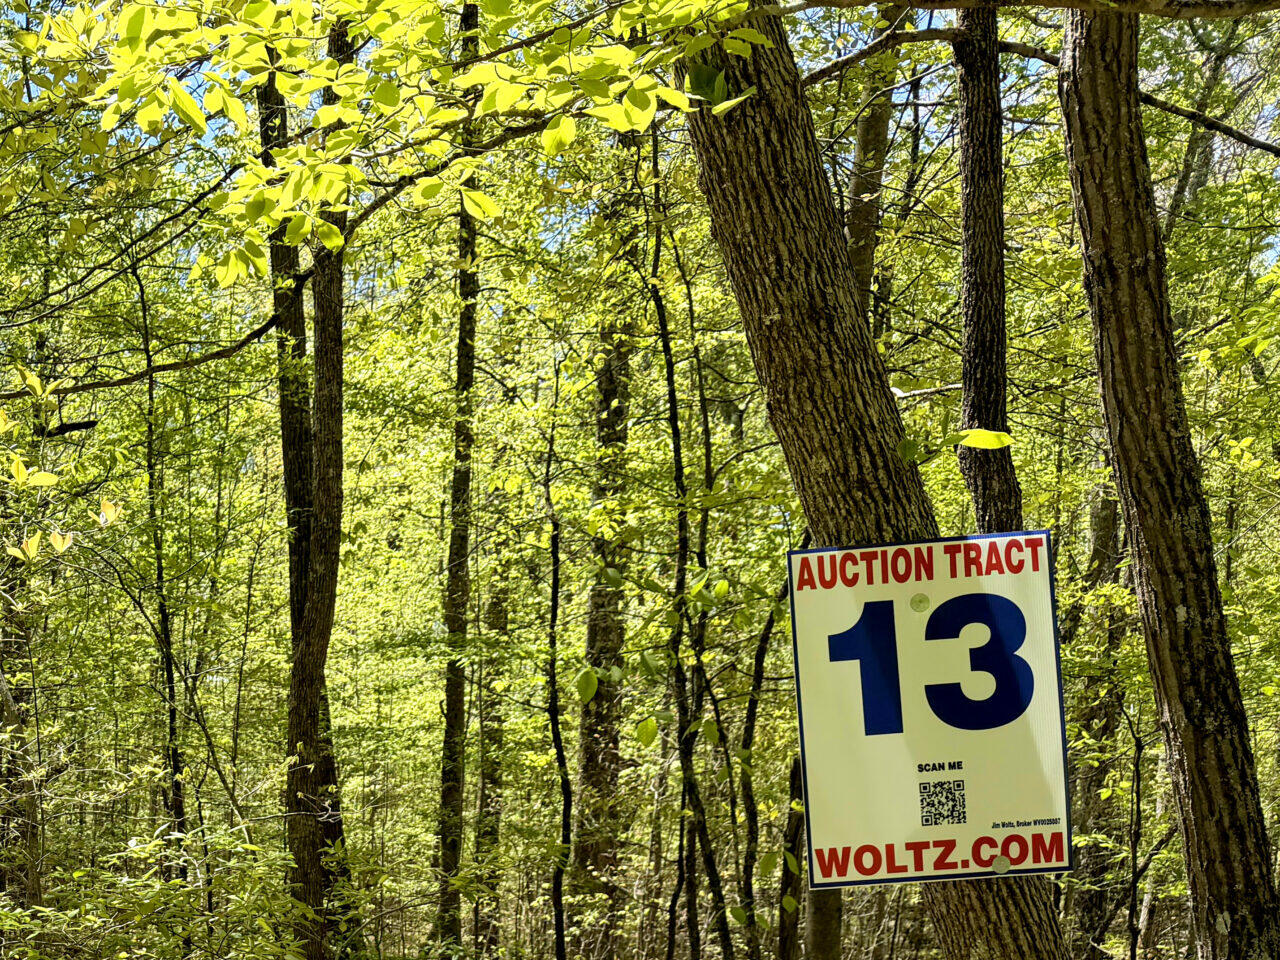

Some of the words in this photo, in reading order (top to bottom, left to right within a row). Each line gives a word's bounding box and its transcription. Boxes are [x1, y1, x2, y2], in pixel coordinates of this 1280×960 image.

[796, 546, 934, 591] AUCTION
[943, 537, 1044, 579] TRACT
[827, 592, 1035, 737] 13
[917, 762, 946, 773] SCAN
[948, 760, 963, 771] ME
[991, 821, 1001, 829] Jim
[1016, 820, 1032, 828] Broker
[814, 831, 1065, 879] WOLTZ.COM
